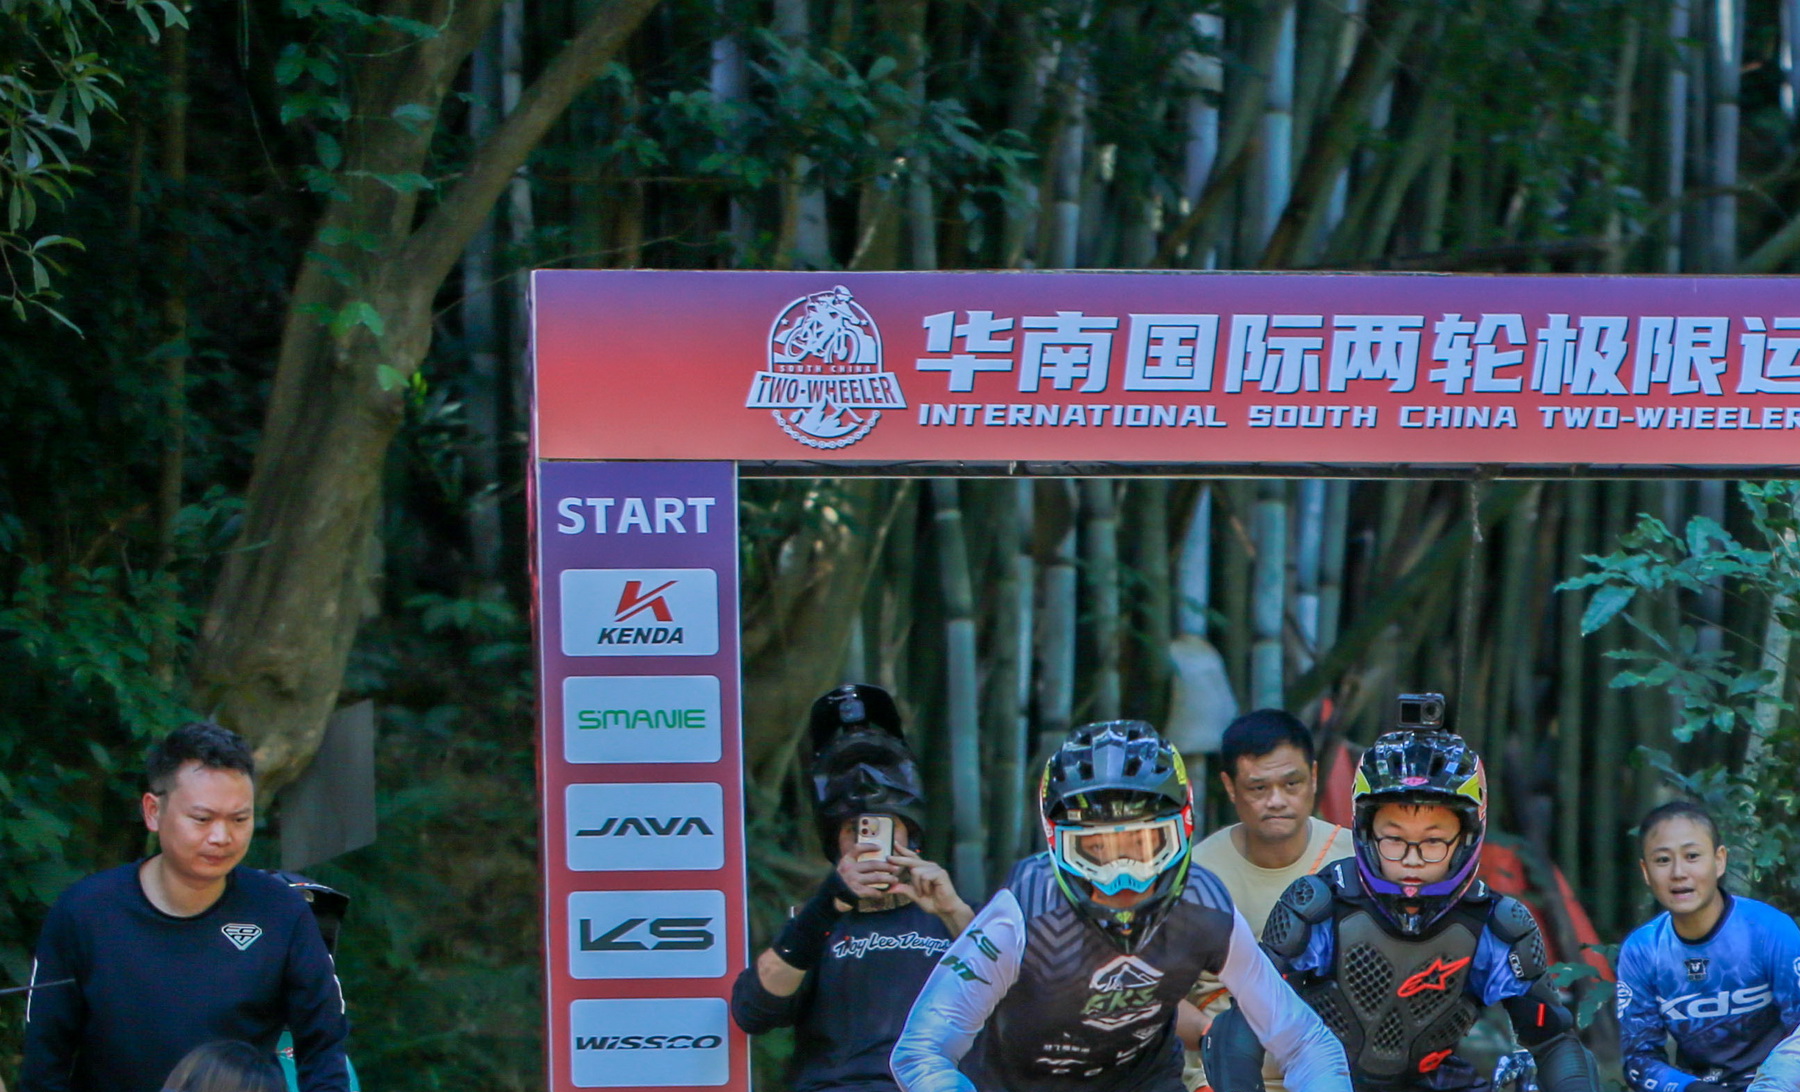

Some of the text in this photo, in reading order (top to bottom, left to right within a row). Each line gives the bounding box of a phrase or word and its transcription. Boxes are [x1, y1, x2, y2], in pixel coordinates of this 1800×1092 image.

[780, 364, 872, 374] SOUTH CHINA
[757, 375, 898, 404] TWO-WHEELER
[918, 404, 1227, 428] INTERNATIONAL
[1248, 404, 1377, 428] SOUTH
[1399, 405, 1519, 428] CHINA
[557, 497, 716, 534] START
[597, 627, 684, 645] KENDA
[575, 816, 714, 837] JAVA
[579, 917, 714, 951] KS
[868, 932, 898, 950] Lee
